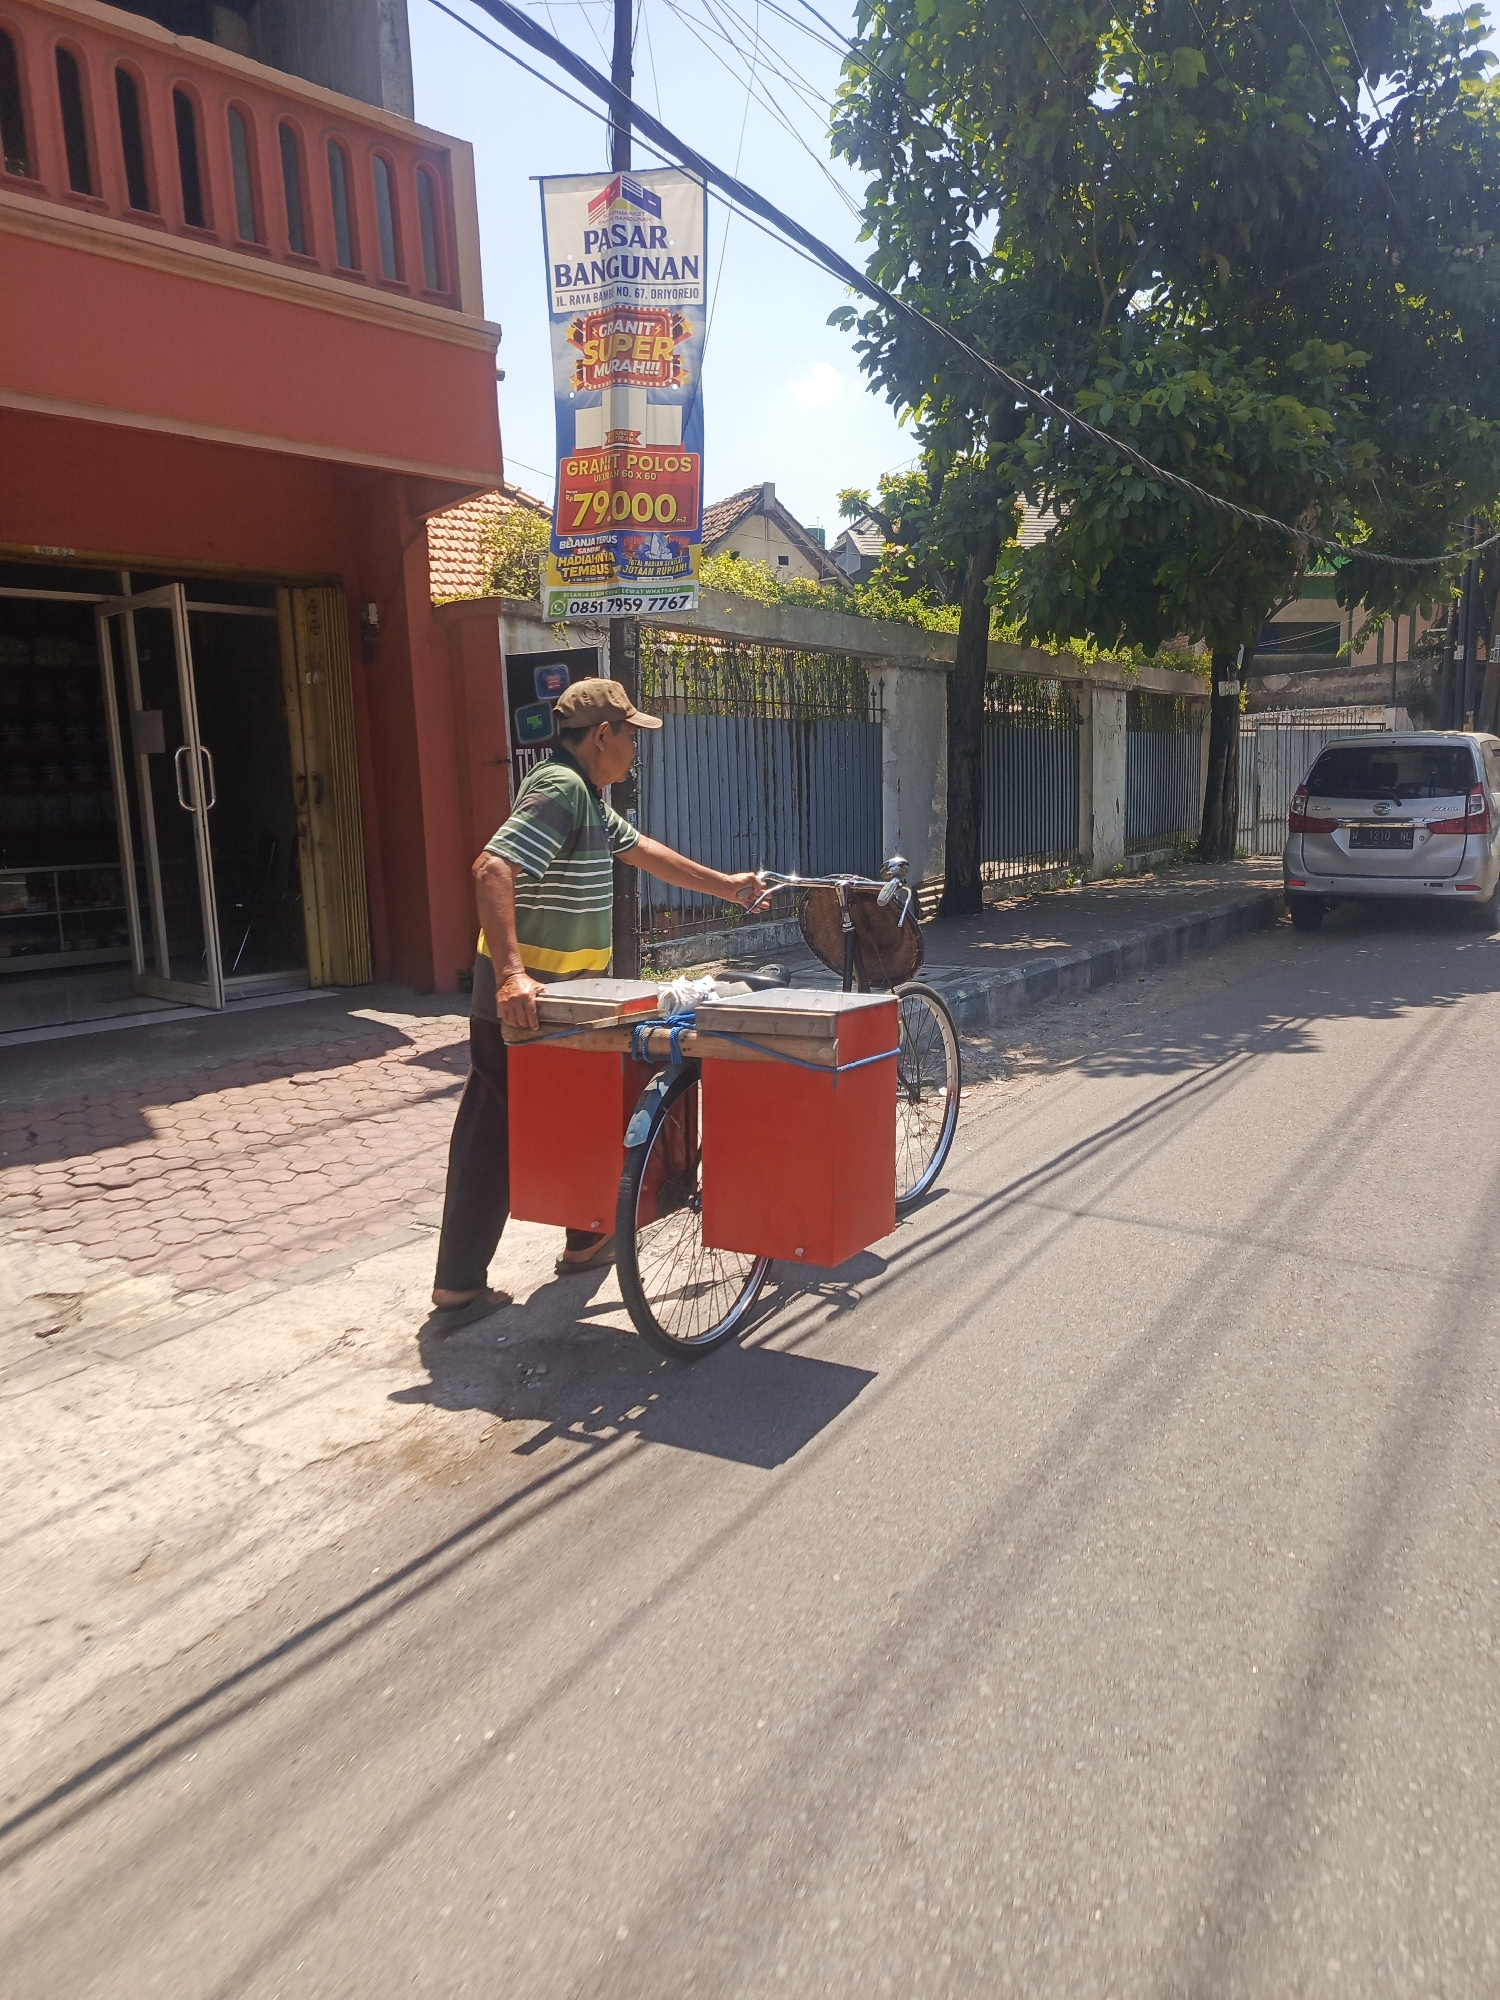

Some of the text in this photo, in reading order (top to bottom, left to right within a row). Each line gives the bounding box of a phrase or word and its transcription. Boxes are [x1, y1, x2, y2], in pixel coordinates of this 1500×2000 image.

[584, 224, 668, 254] PASAR
[554, 255, 699, 288] BANGUNAN
[556, 295, 567, 307] JL.
[569, 293, 591, 305] RAYA
[616, 286, 632, 297] NO.
[651, 288, 699, 299] DRIYOREJO
[598, 319, 655, 338] GRANIT
[583, 333, 675, 365] SUPER
[593, 359, 662, 379] MURAH!!!
[567, 453, 692, 476] GRANIT POLOS
[594, 470, 619, 482] UKURAN
[622, 470, 634, 478] 60
[645, 472, 657, 480] 60
[572, 490, 677, 527] 79.000
[559, 535, 618, 549] BELANJA TERUS
[558, 552, 616, 567] HADIAHNYA
[622, 563, 687, 576] JUTAAN RUPIAH!
[569, 595, 690, 615] 0851 7959 7767
